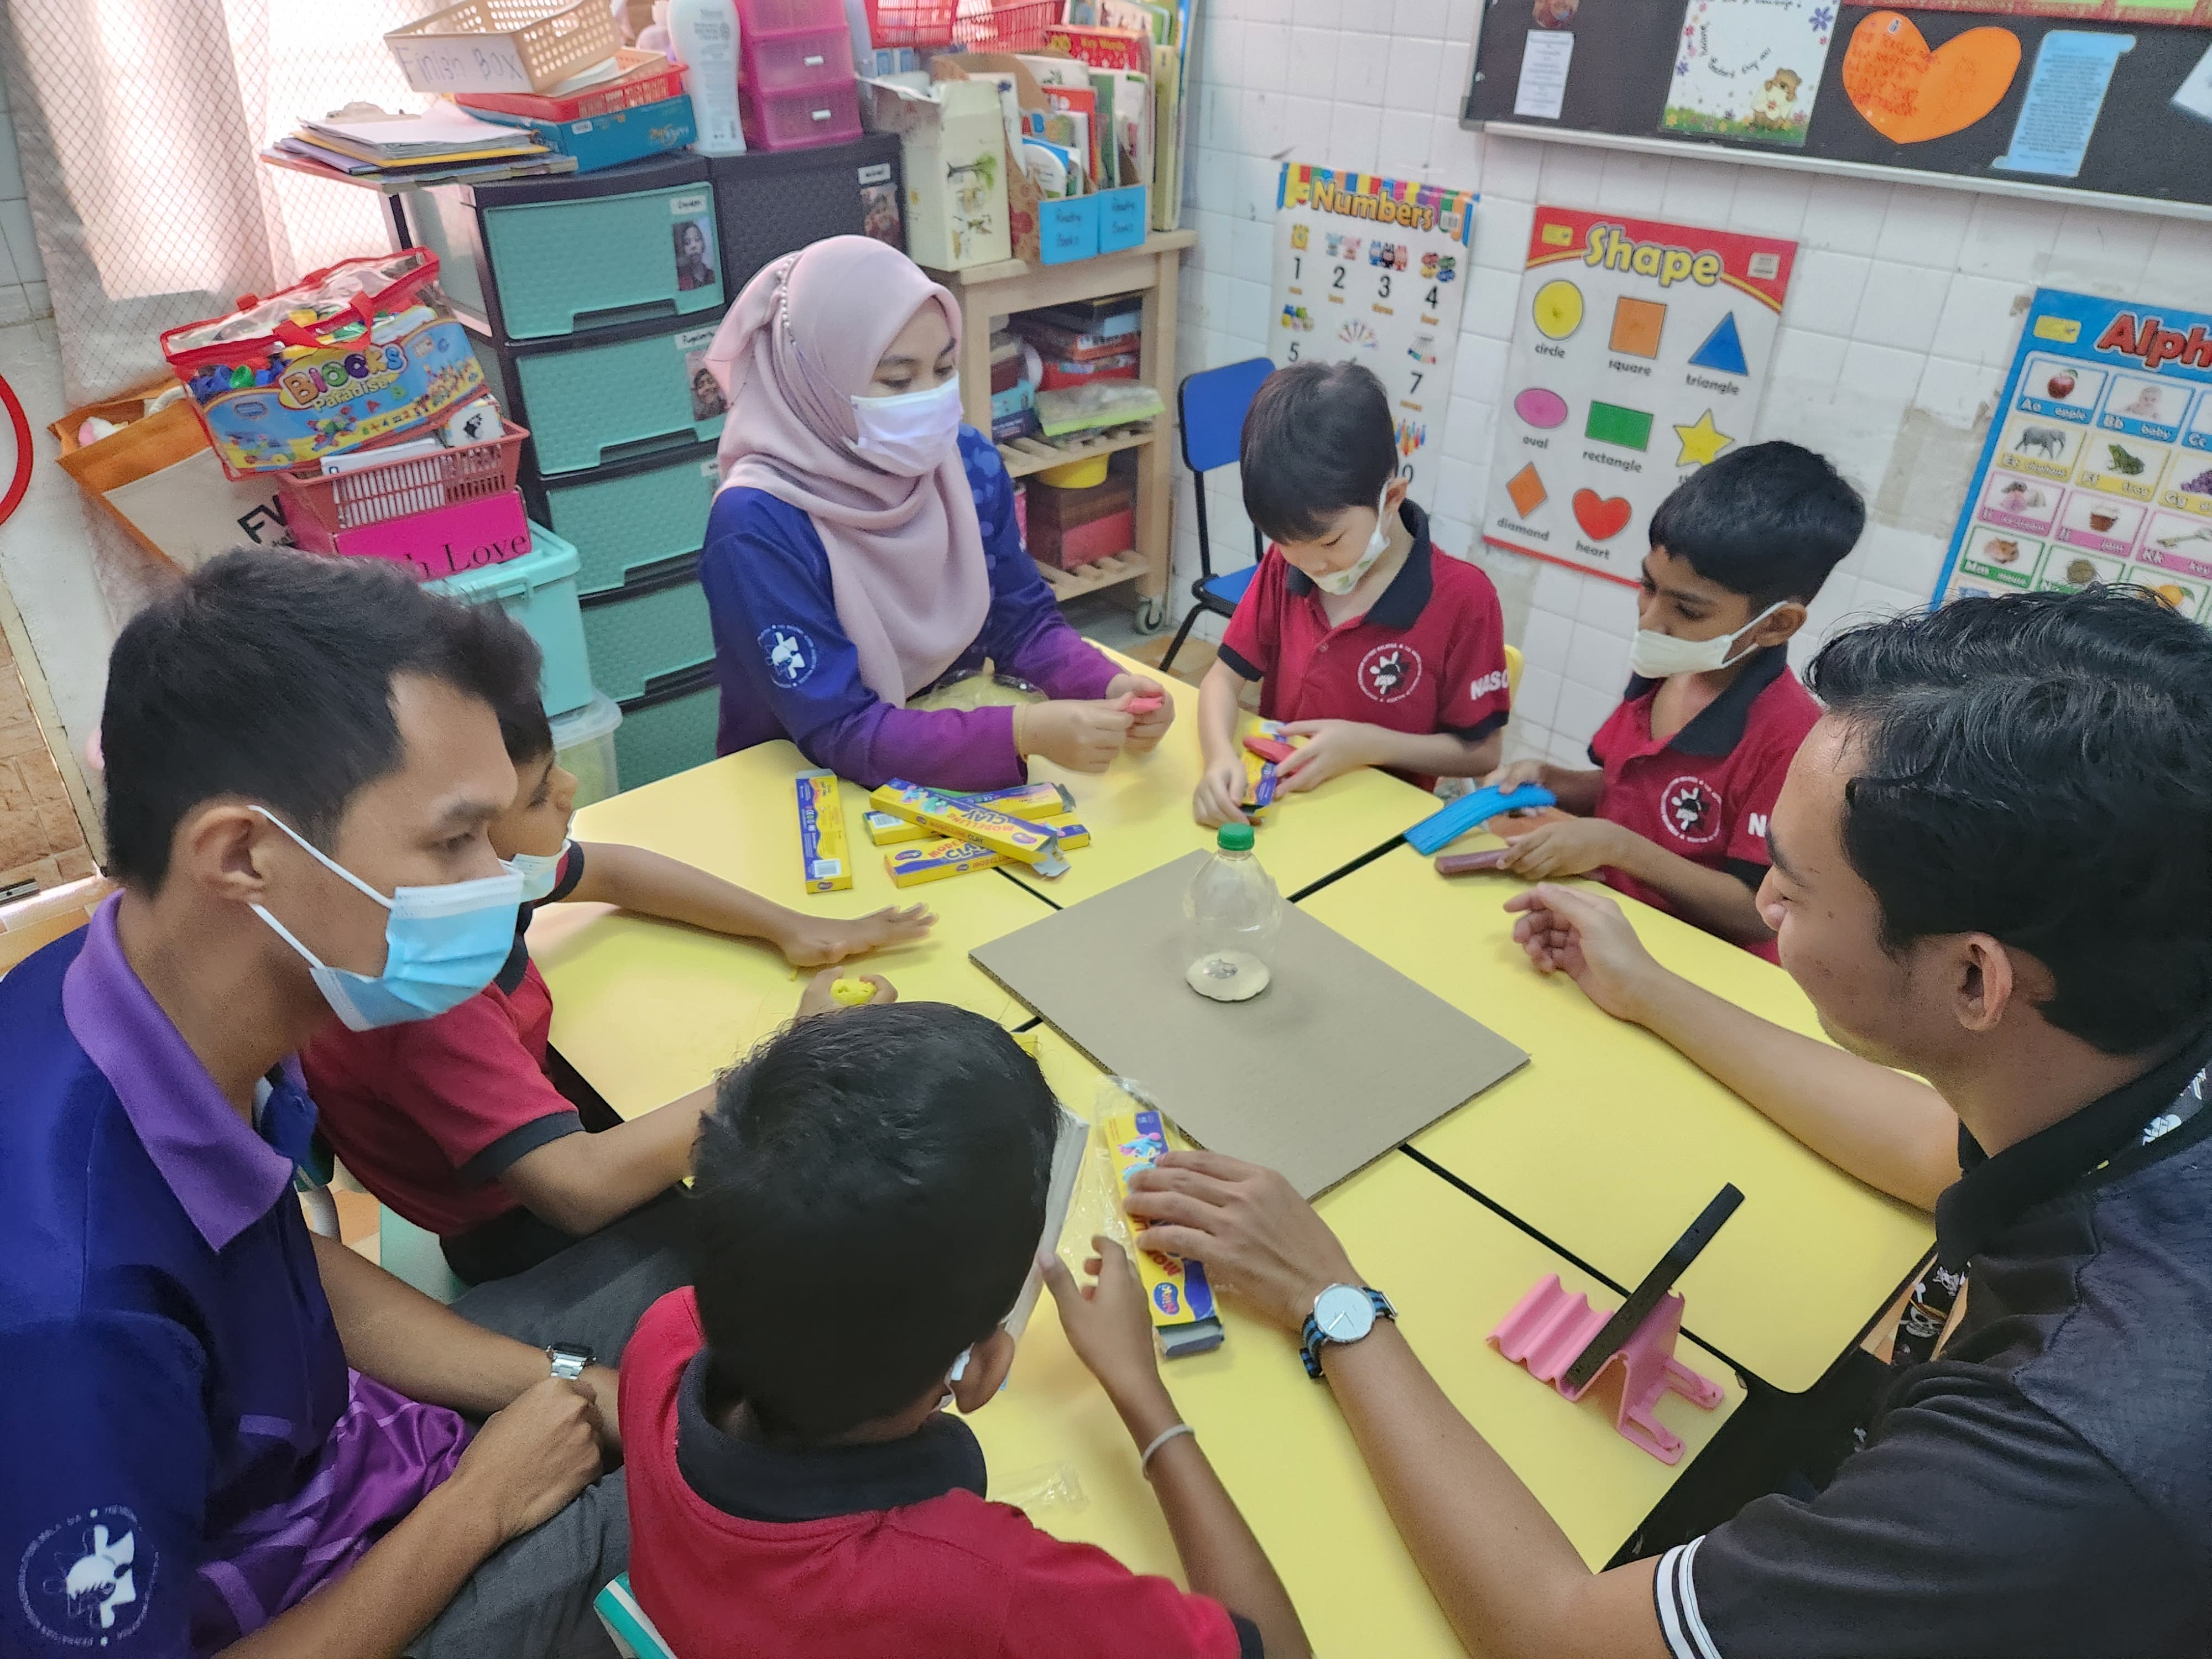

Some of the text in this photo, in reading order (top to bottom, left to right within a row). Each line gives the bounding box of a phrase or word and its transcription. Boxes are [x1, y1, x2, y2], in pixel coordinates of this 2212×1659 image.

[395, 46, 467, 84] Finish
[1311, 180, 1433, 232] Numbers
[1294, 256, 1301, 280] 1
[1583, 226, 1721, 288] Shape
[1333, 266, 1345, 289] 2
[1378, 275, 1390, 299] 3
[1424, 285, 1439, 309] 4
[1287, 341, 1300, 362] 5
[1535, 343, 1566, 359] circle
[283, 344, 405, 405] Blocks
[1608, 359, 1652, 377] square
[312, 375, 390, 413] Paradise
[1411, 371, 1423, 394] 7
[1686, 373, 1740, 395] triangle
[2020, 398, 2043, 414] Aa
[2103, 415, 2172, 441] Bb baby
[2188, 431, 2208, 447] Cc
[1522, 435, 1550, 450] oval
[1582, 450, 1642, 473] rectangle
[1497, 517, 1550, 541] diamond
[443, 535, 527, 573] Love
[1575, 540, 1610, 560] heart
[947, 813, 1015, 832] MODELLING
[961, 808, 1009, 825] CLAY
[968, 833, 984, 844] CLAY
